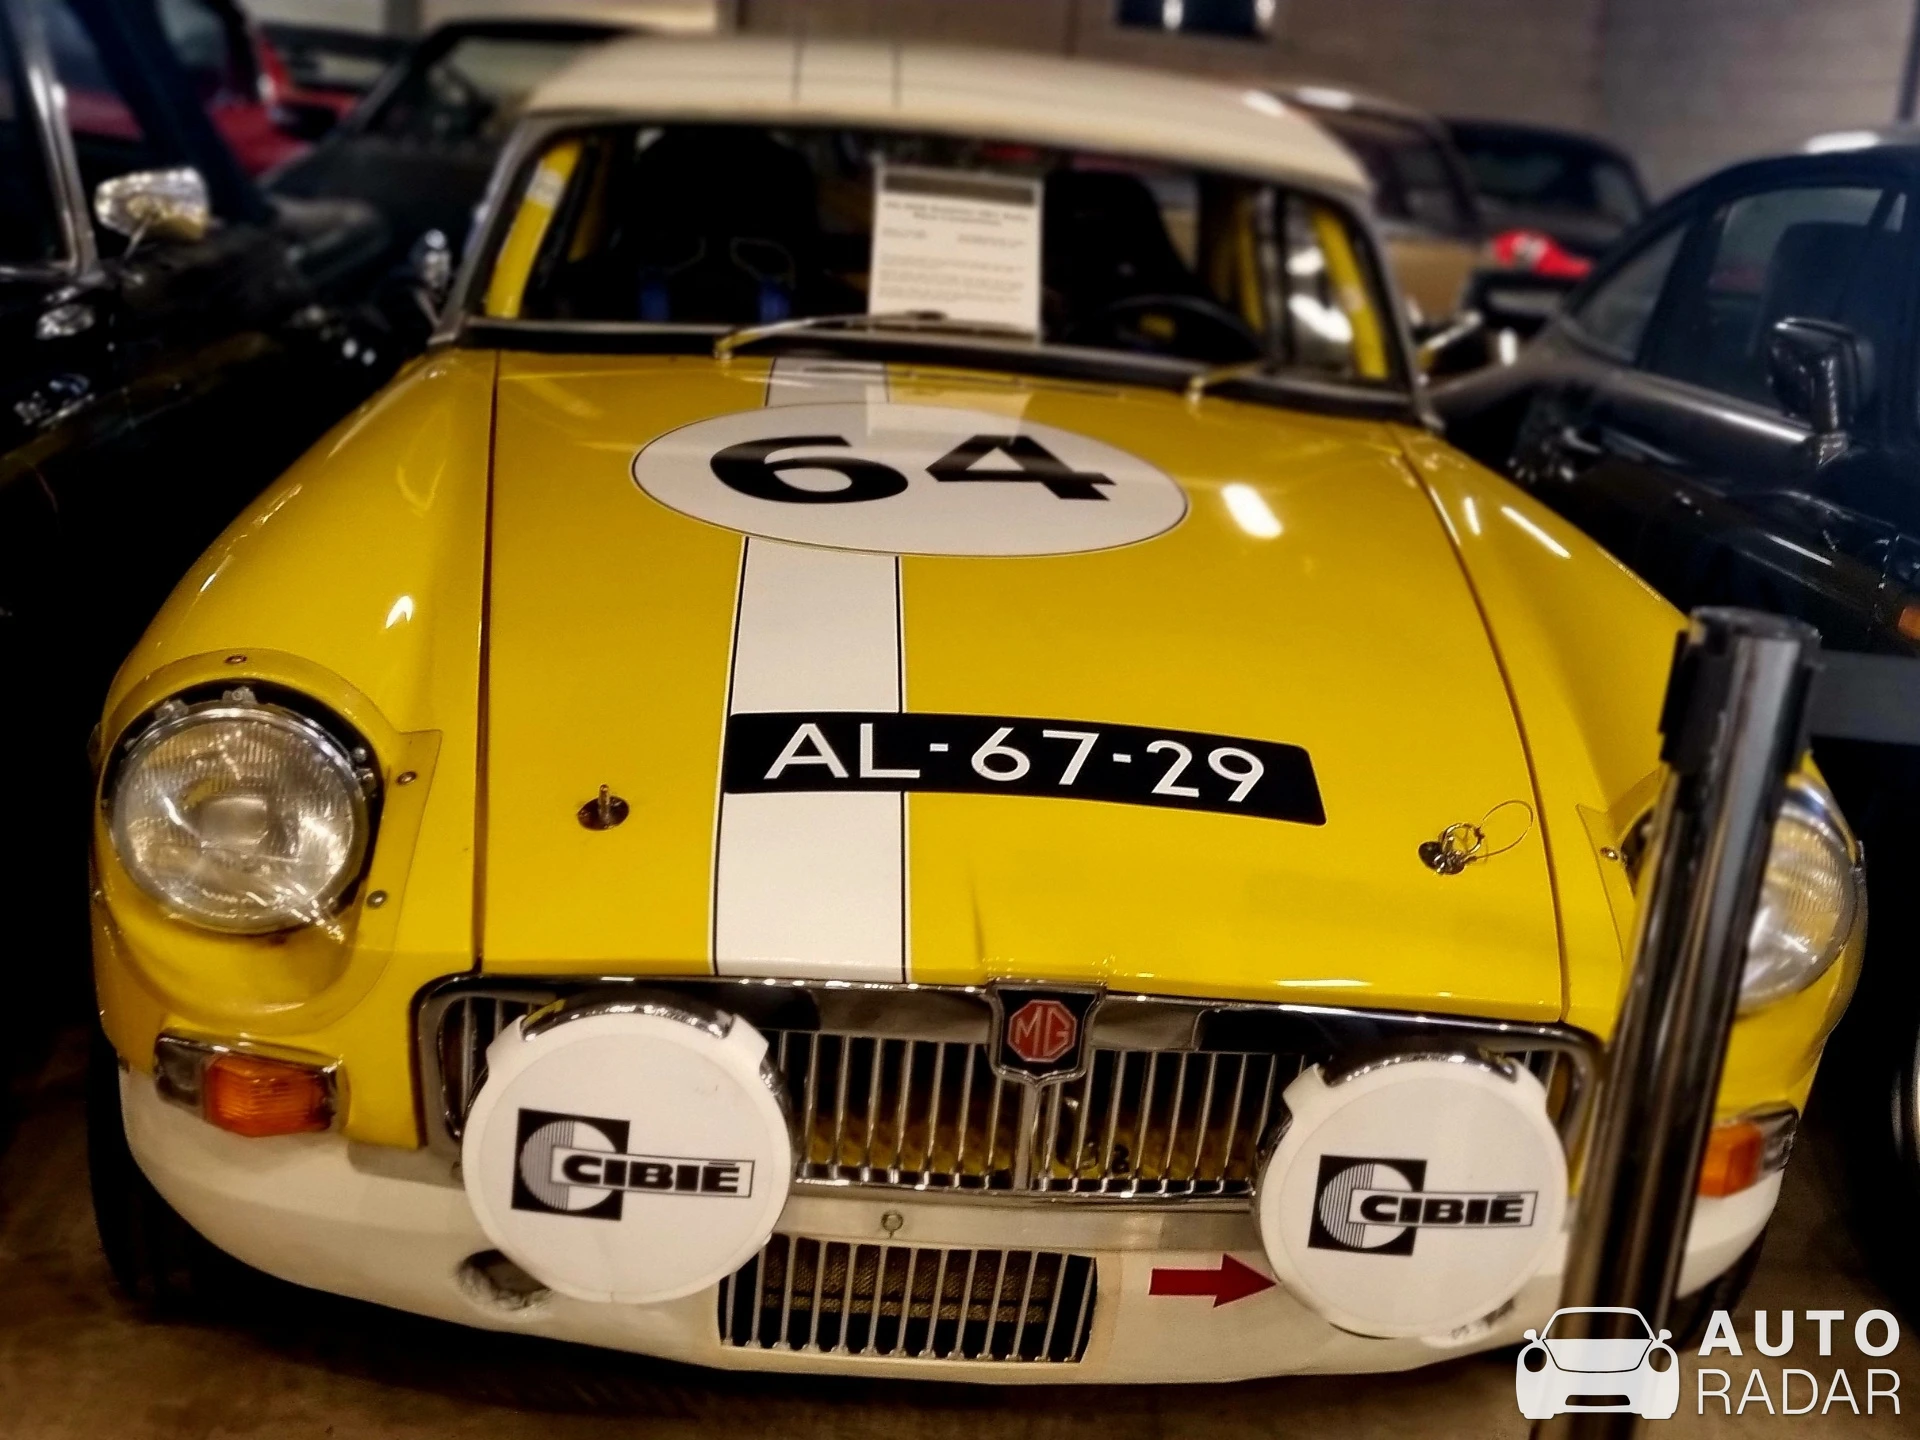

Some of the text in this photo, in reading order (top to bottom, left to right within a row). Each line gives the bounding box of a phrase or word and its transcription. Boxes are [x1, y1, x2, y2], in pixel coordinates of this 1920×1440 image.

[710, 435, 1117, 504] 64
[763, 722, 1265, 802] AL-67-29
[1014, 1005, 1071, 1058] MG
